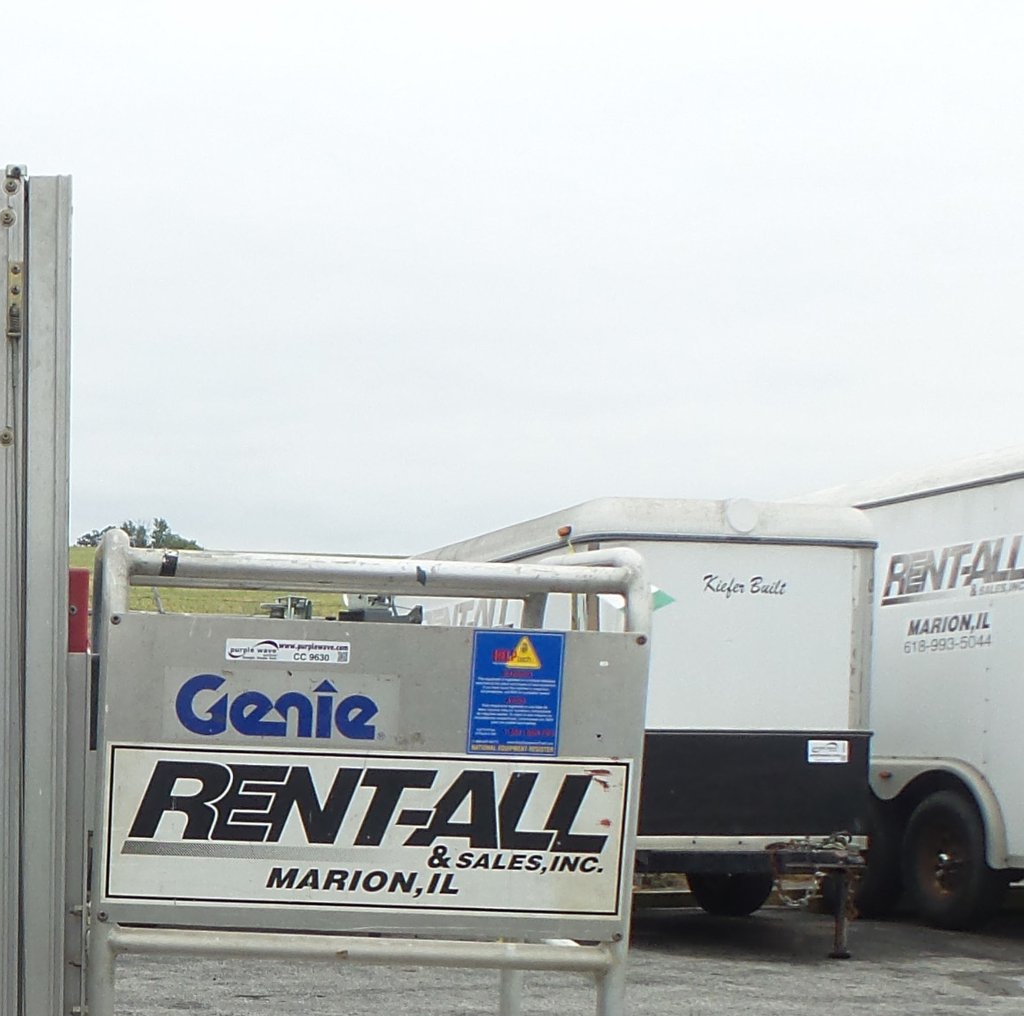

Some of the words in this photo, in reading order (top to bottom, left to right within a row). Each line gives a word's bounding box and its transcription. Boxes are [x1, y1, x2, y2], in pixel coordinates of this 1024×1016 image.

[882, 535, 1024, 598] RENT-ALL
[703, 574, 745, 599] Kiefer
[750, 576, 787, 595] Built
[907, 612, 991, 637] MARION,IL
[230, 646, 255, 655] purple
[278, 642, 349, 652] www.purplewave.com
[293, 652, 307, 661] CC
[309, 653, 330, 662] 9630
[903, 635, 992, 654] 618-993-5044
[175, 673, 379, 741] Genie
[127, 760, 609, 855] RENT-ALL
[427, 845, 451, 869] &
[455, 853, 605, 874] SALES,INC.
[265, 866, 460, 898] MARION,IL
